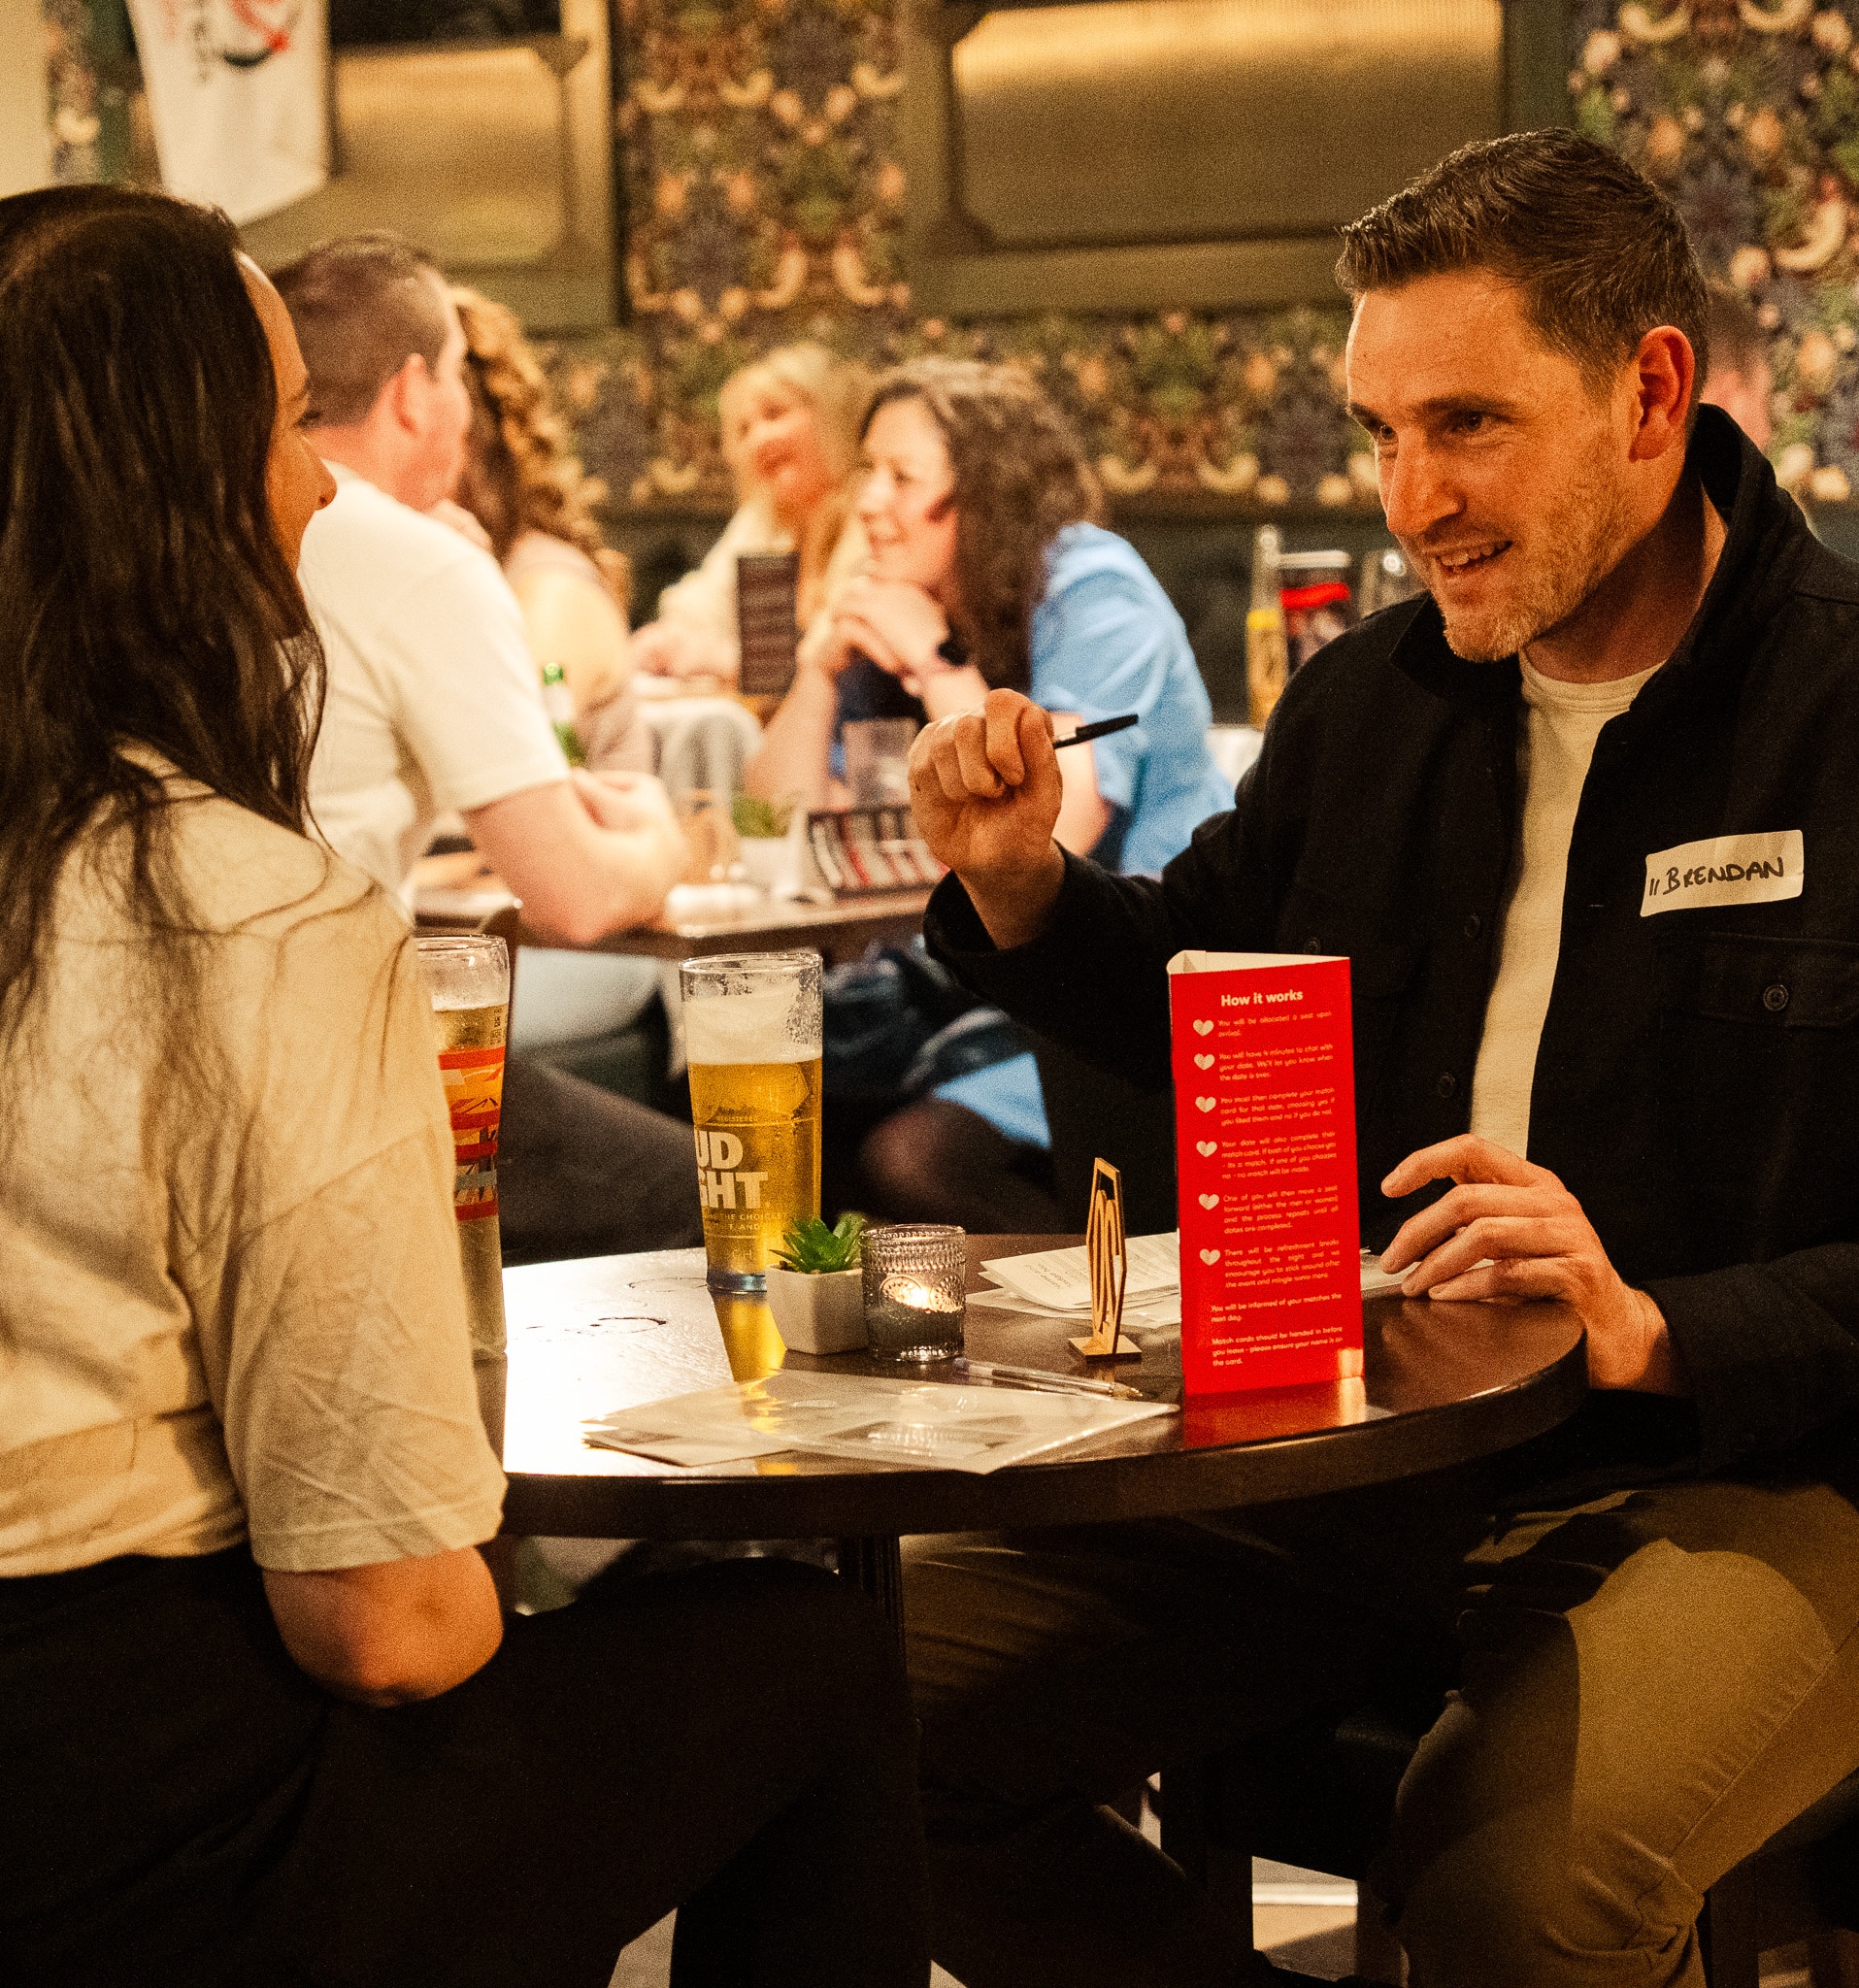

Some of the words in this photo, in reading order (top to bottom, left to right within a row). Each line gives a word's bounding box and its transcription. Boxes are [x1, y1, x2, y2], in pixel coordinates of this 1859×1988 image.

[1663, 857, 1785, 896] BRENDAN
[1221, 994, 1250, 1007] How
[1253, 993, 1263, 1004] it
[1265, 989, 1304, 1004] works
